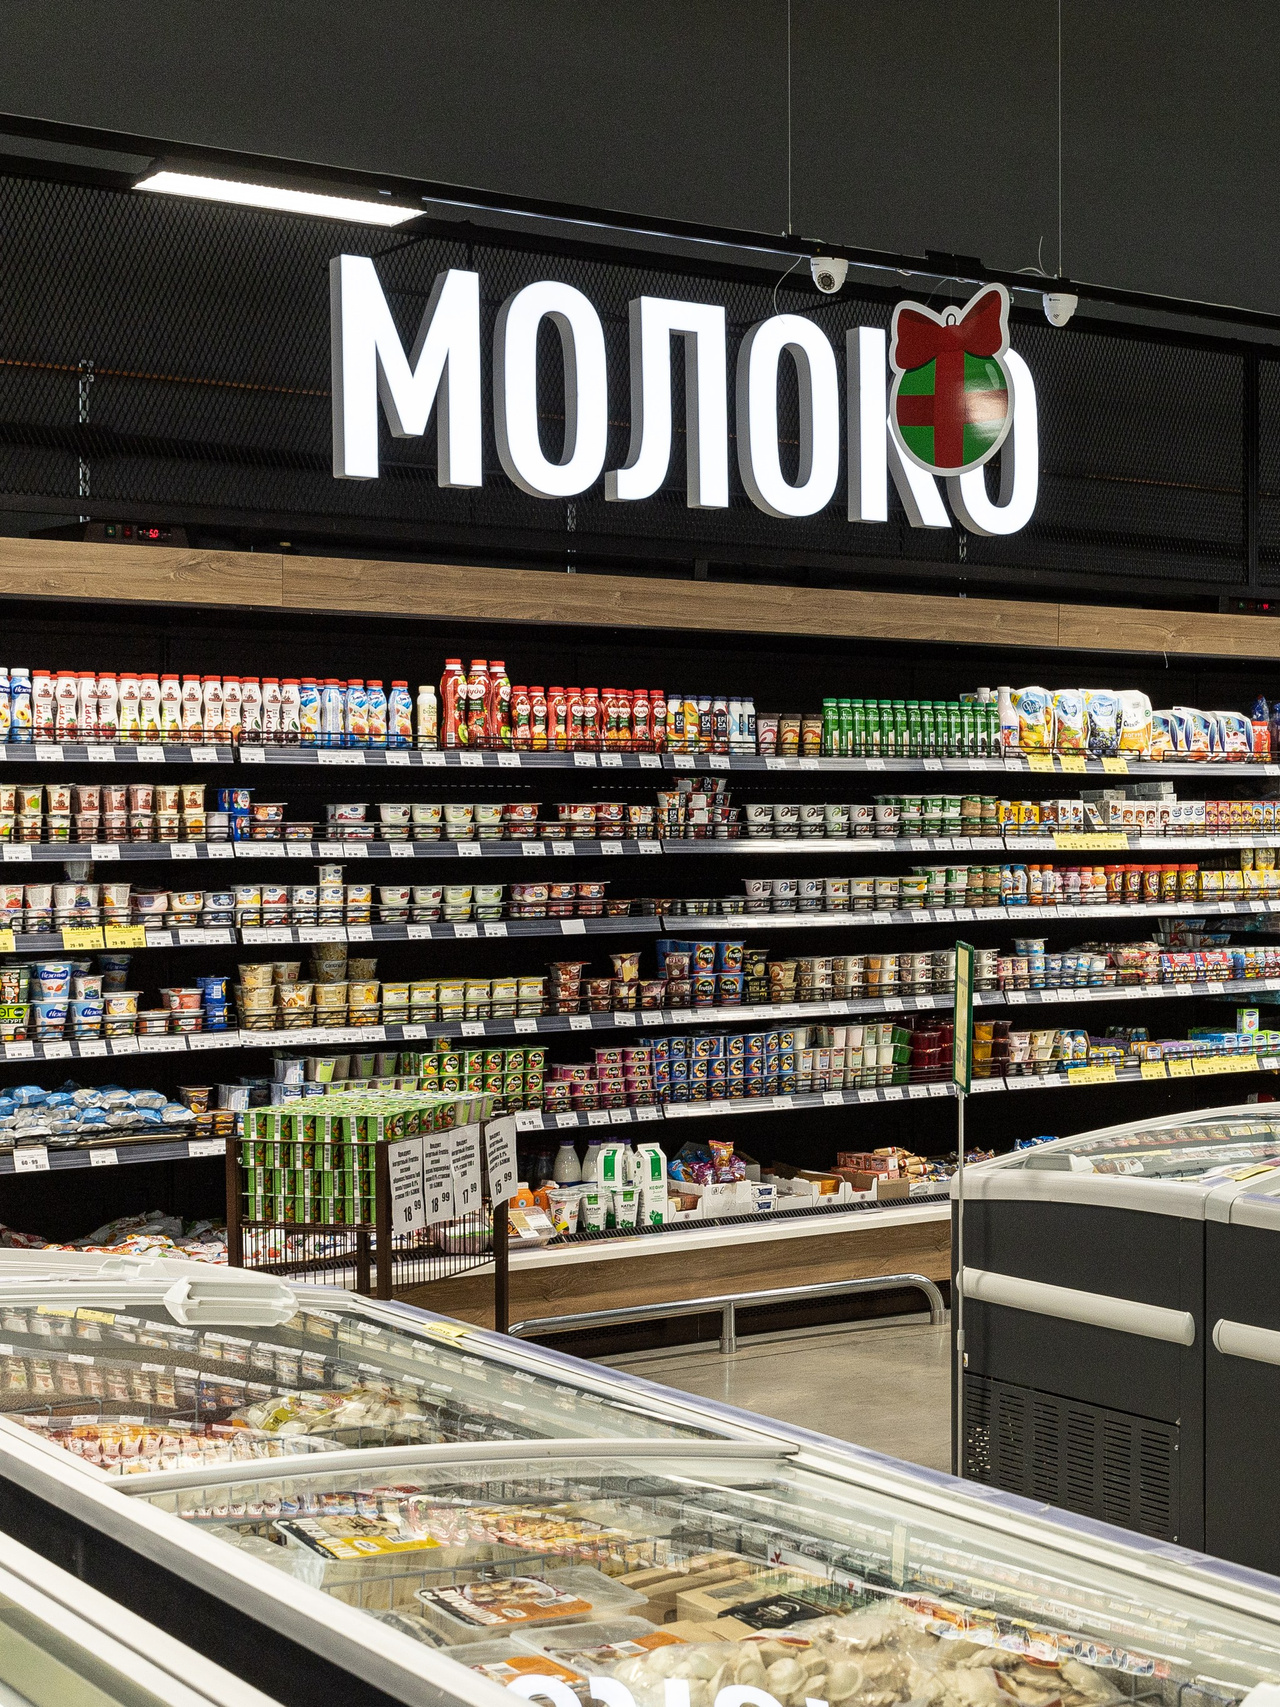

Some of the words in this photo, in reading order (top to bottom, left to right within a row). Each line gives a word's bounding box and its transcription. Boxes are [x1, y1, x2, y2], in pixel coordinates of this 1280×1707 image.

[330, 254, 1039, 536] МОЛОКО
[504, 1171, 512, 1182] 99
[470, 1182, 477, 1193] 99
[495, 1179, 502, 1196] 15
[442, 1192, 450, 1202] 99
[462, 1188, 469, 1204] 17
[414, 1199, 421, 1210] 99
[431, 1197, 439, 1213] 18
[403, 1206, 412, 1222] 18
